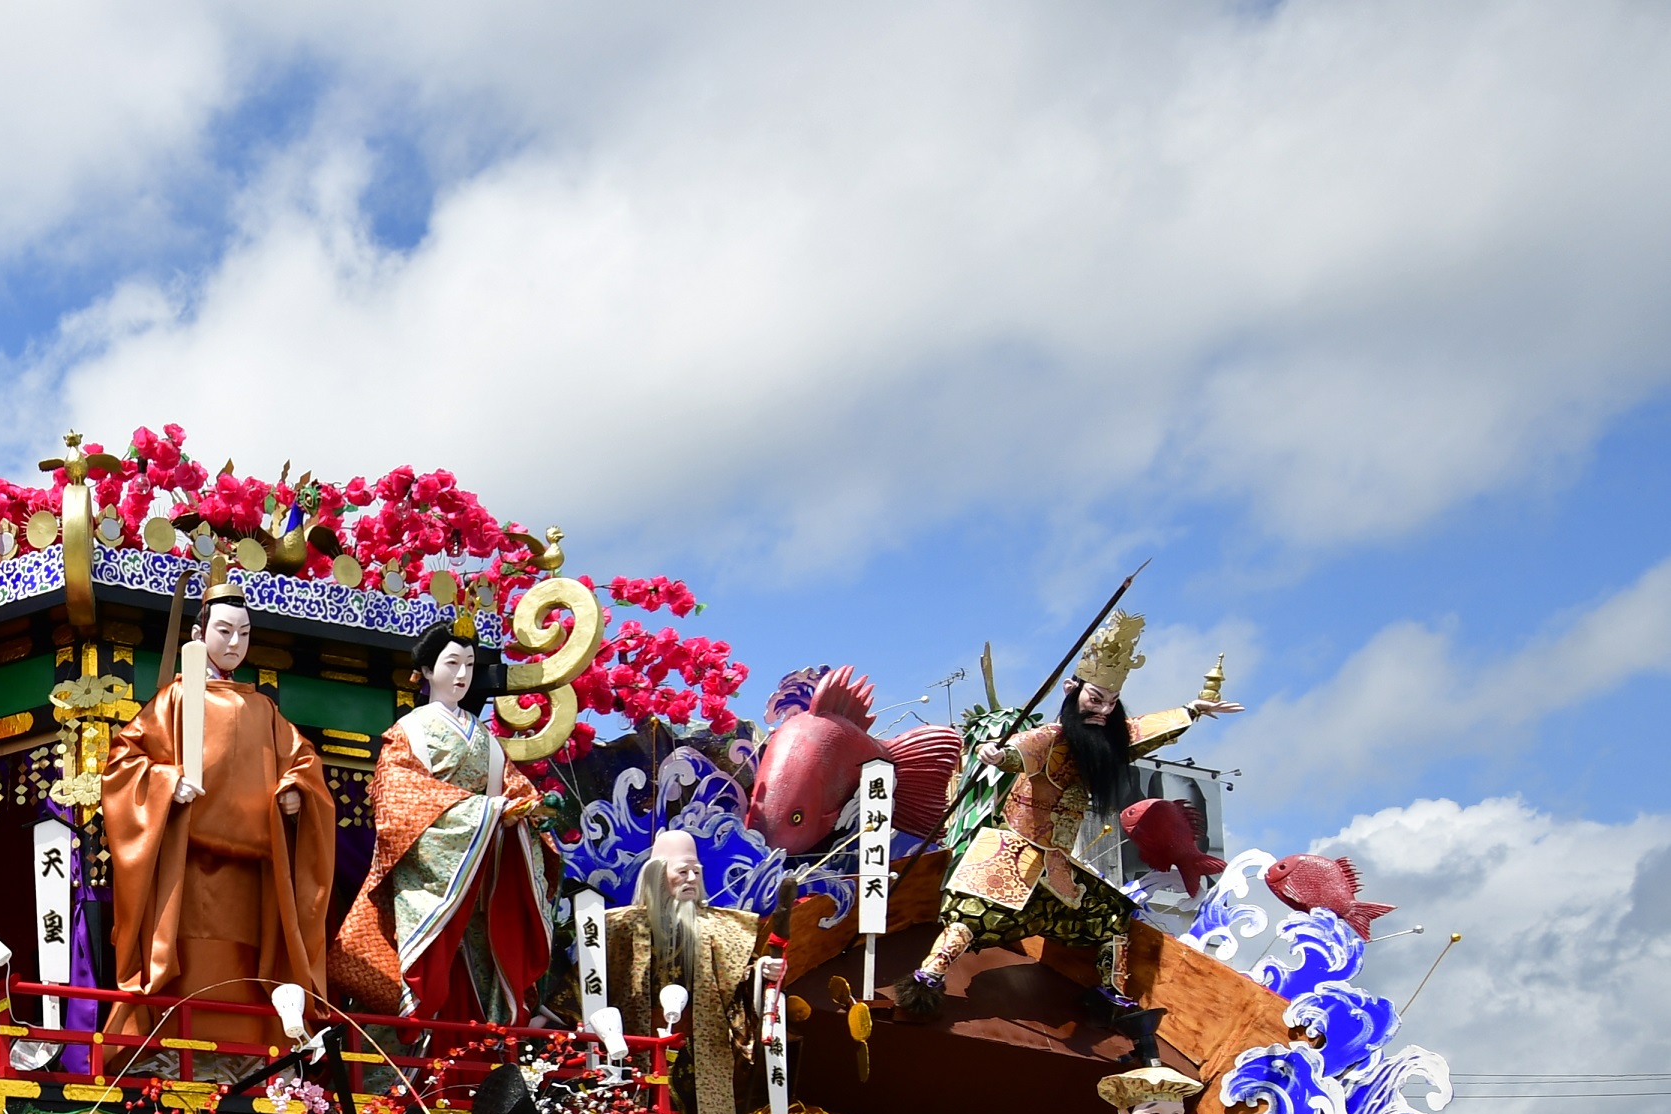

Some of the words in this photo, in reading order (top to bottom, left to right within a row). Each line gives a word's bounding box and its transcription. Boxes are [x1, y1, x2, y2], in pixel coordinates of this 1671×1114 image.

[864, 777, 889, 899] 毘沙門天
[40, 846, 66, 944] 天皇
[582, 915, 604, 997] 皇后
